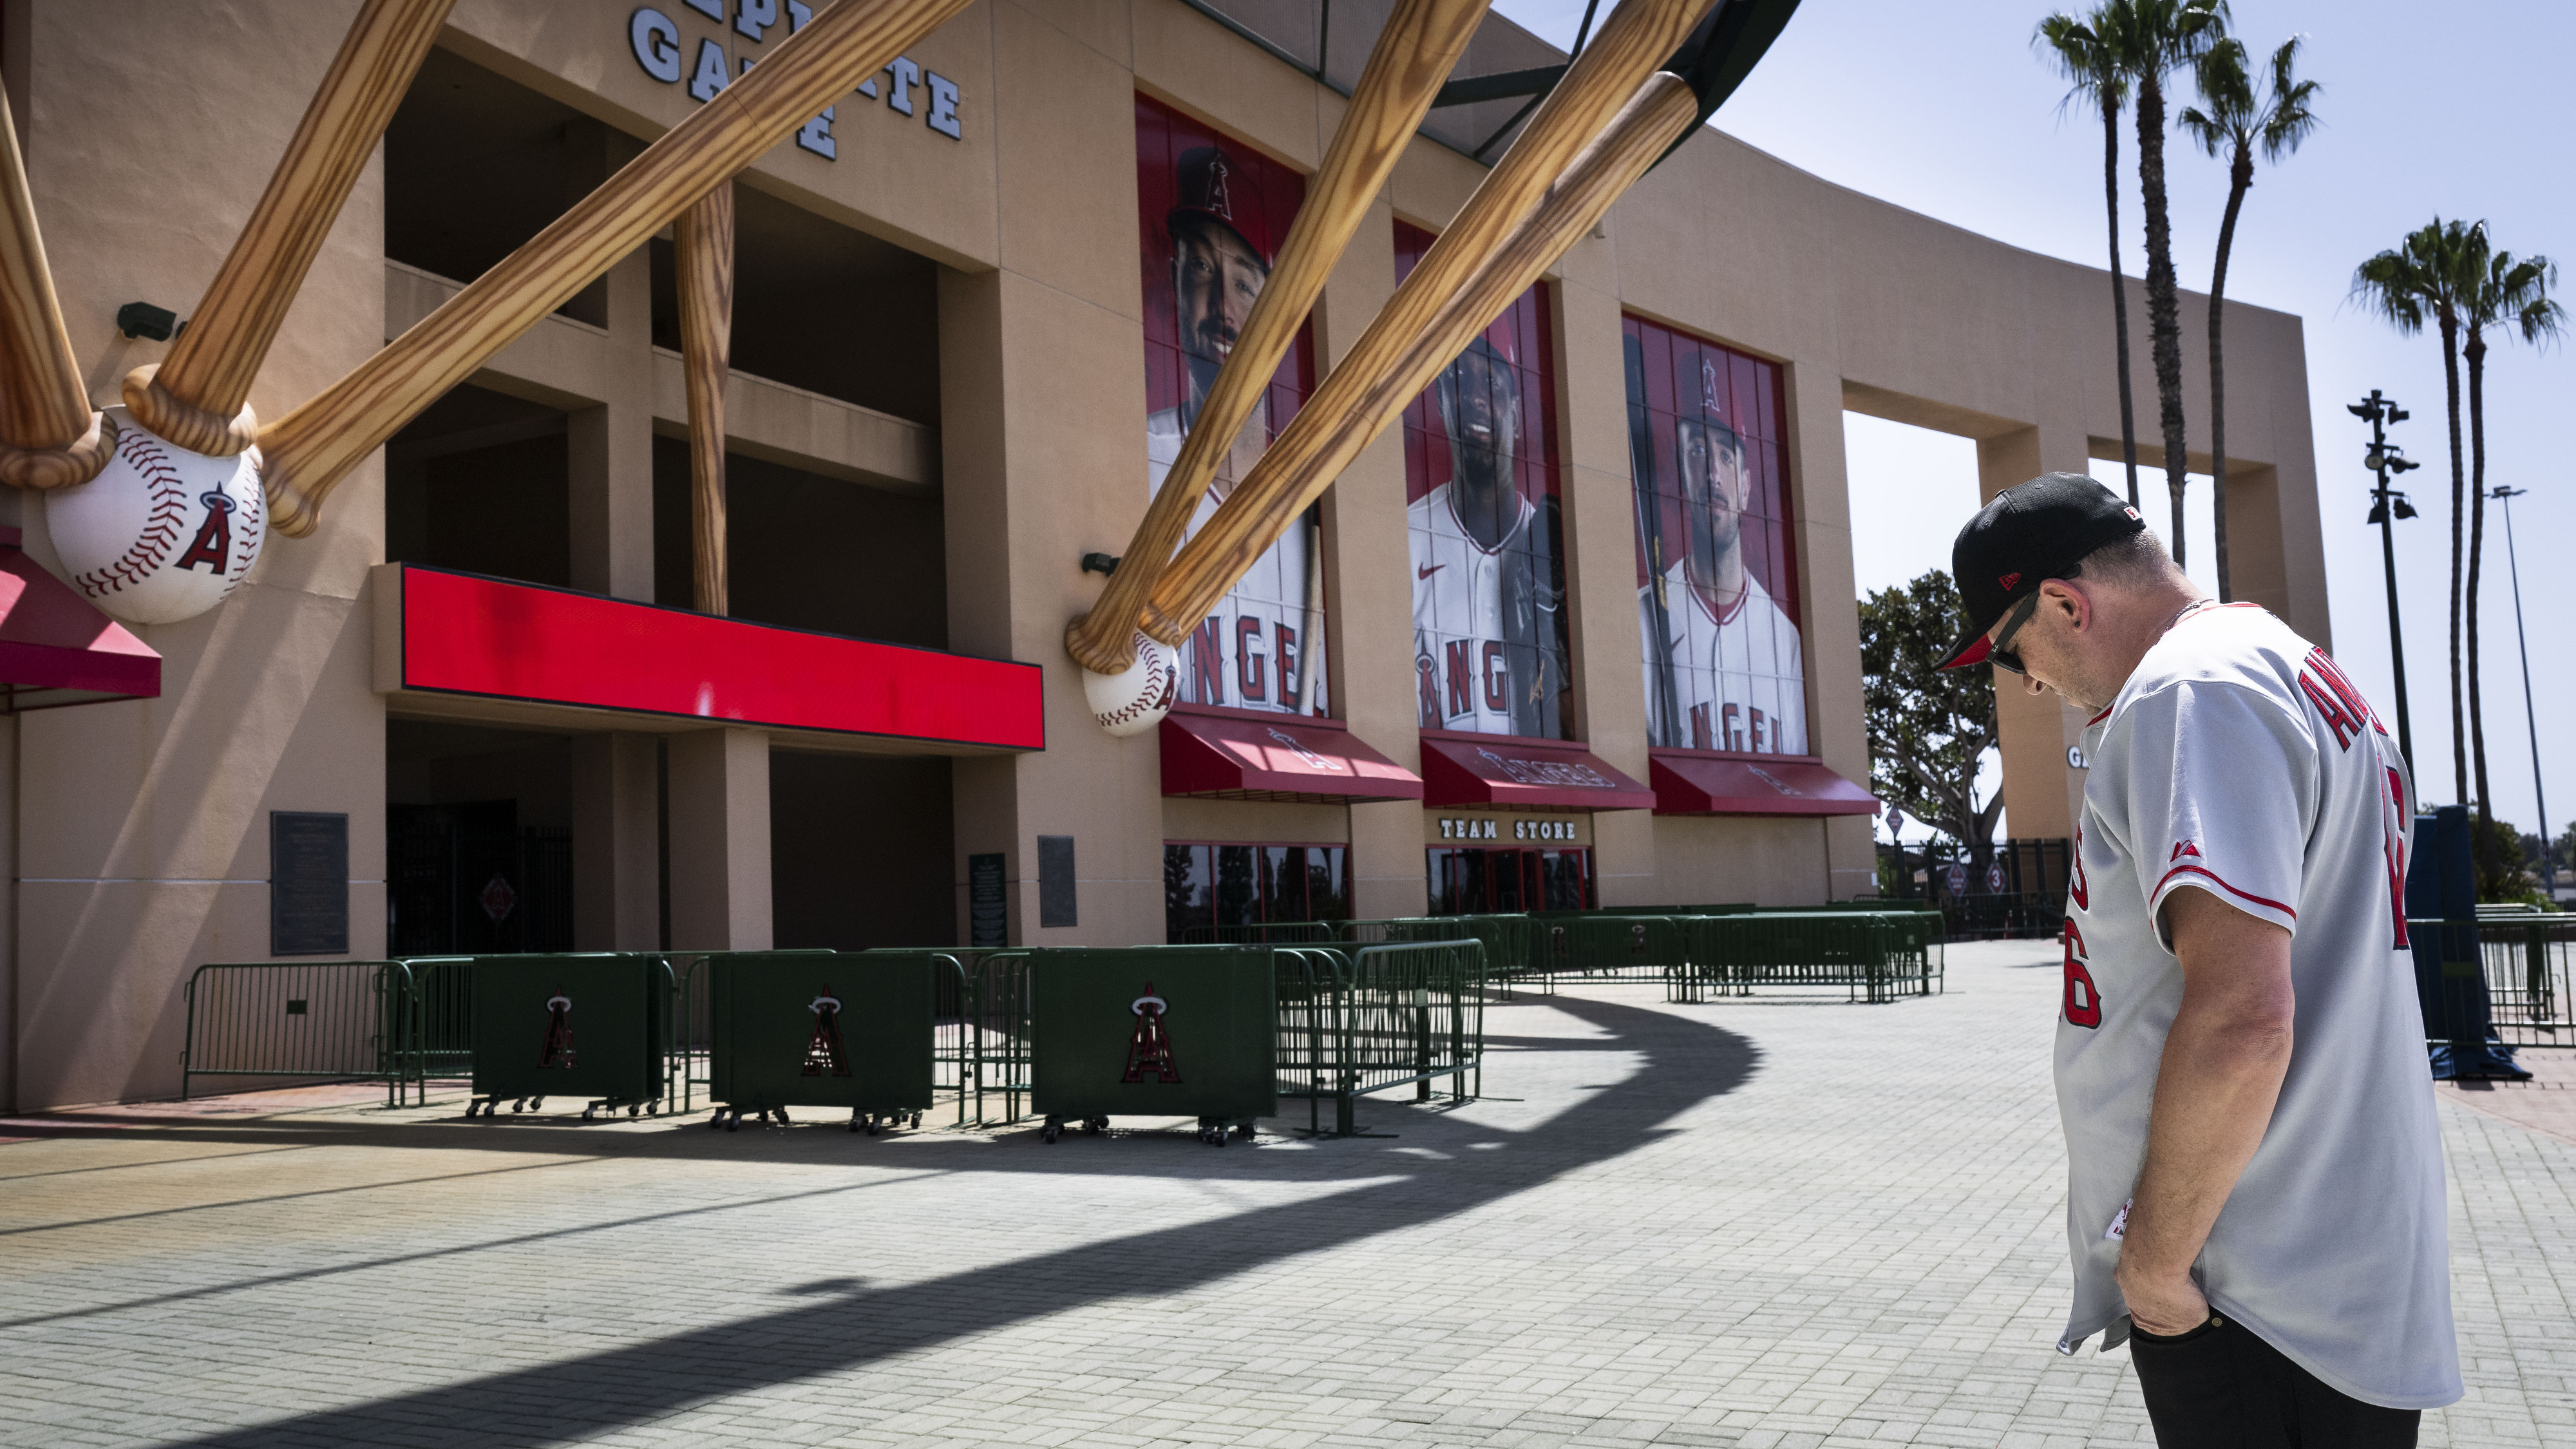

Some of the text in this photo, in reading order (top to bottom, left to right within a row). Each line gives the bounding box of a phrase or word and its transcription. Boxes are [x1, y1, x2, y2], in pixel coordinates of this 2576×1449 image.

[628, 6, 837, 160] GAE
[175, 480, 237, 576] A
[1193, 615, 1324, 717] NGE
[1440, 818, 1576, 840] TEAM STORE
[1992, 869, 2001, 887] 3
